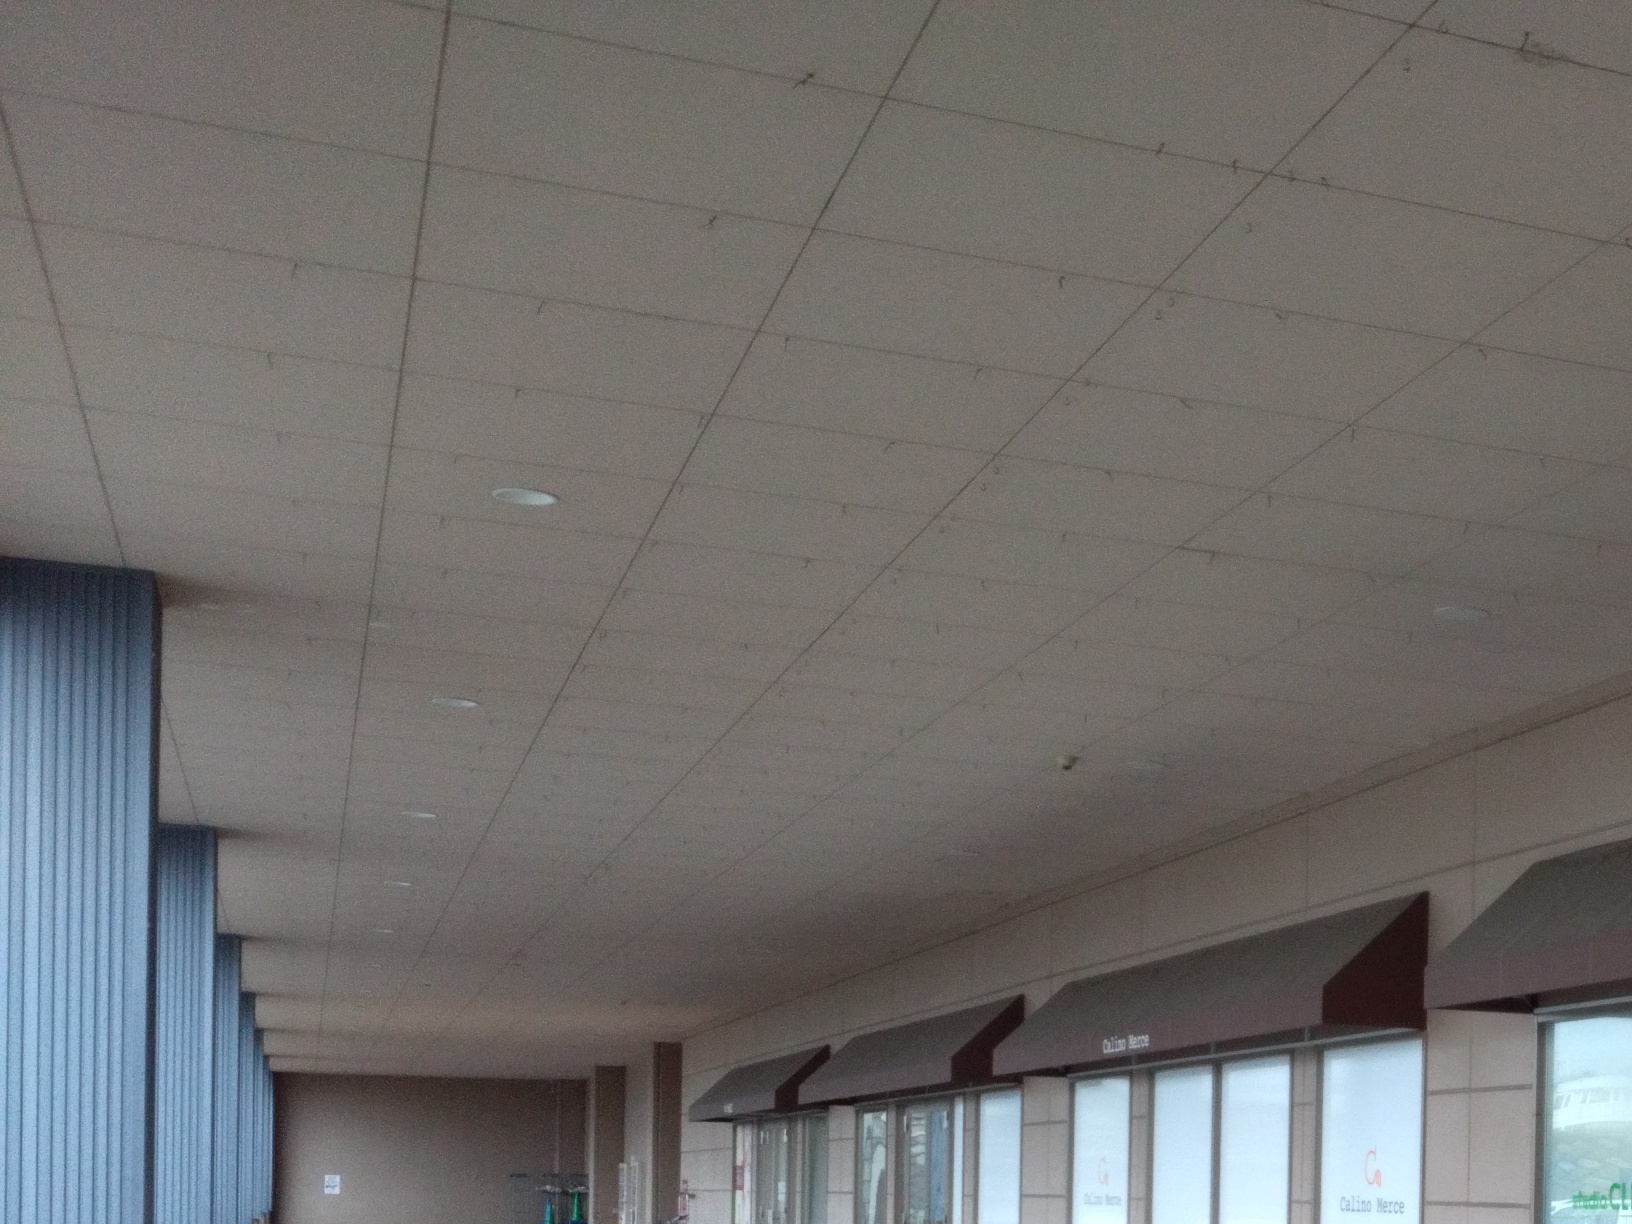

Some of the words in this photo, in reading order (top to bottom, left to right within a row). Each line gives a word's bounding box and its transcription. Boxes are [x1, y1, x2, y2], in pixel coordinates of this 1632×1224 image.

[1102, 1036, 1126, 1054] Calino
[1129, 1034, 1149, 1049] Merce
[1340, 1195, 1372, 1213] Calino
[1376, 1197, 1405, 1215] Merce
[1571, 1190, 1608, 1210] studio
